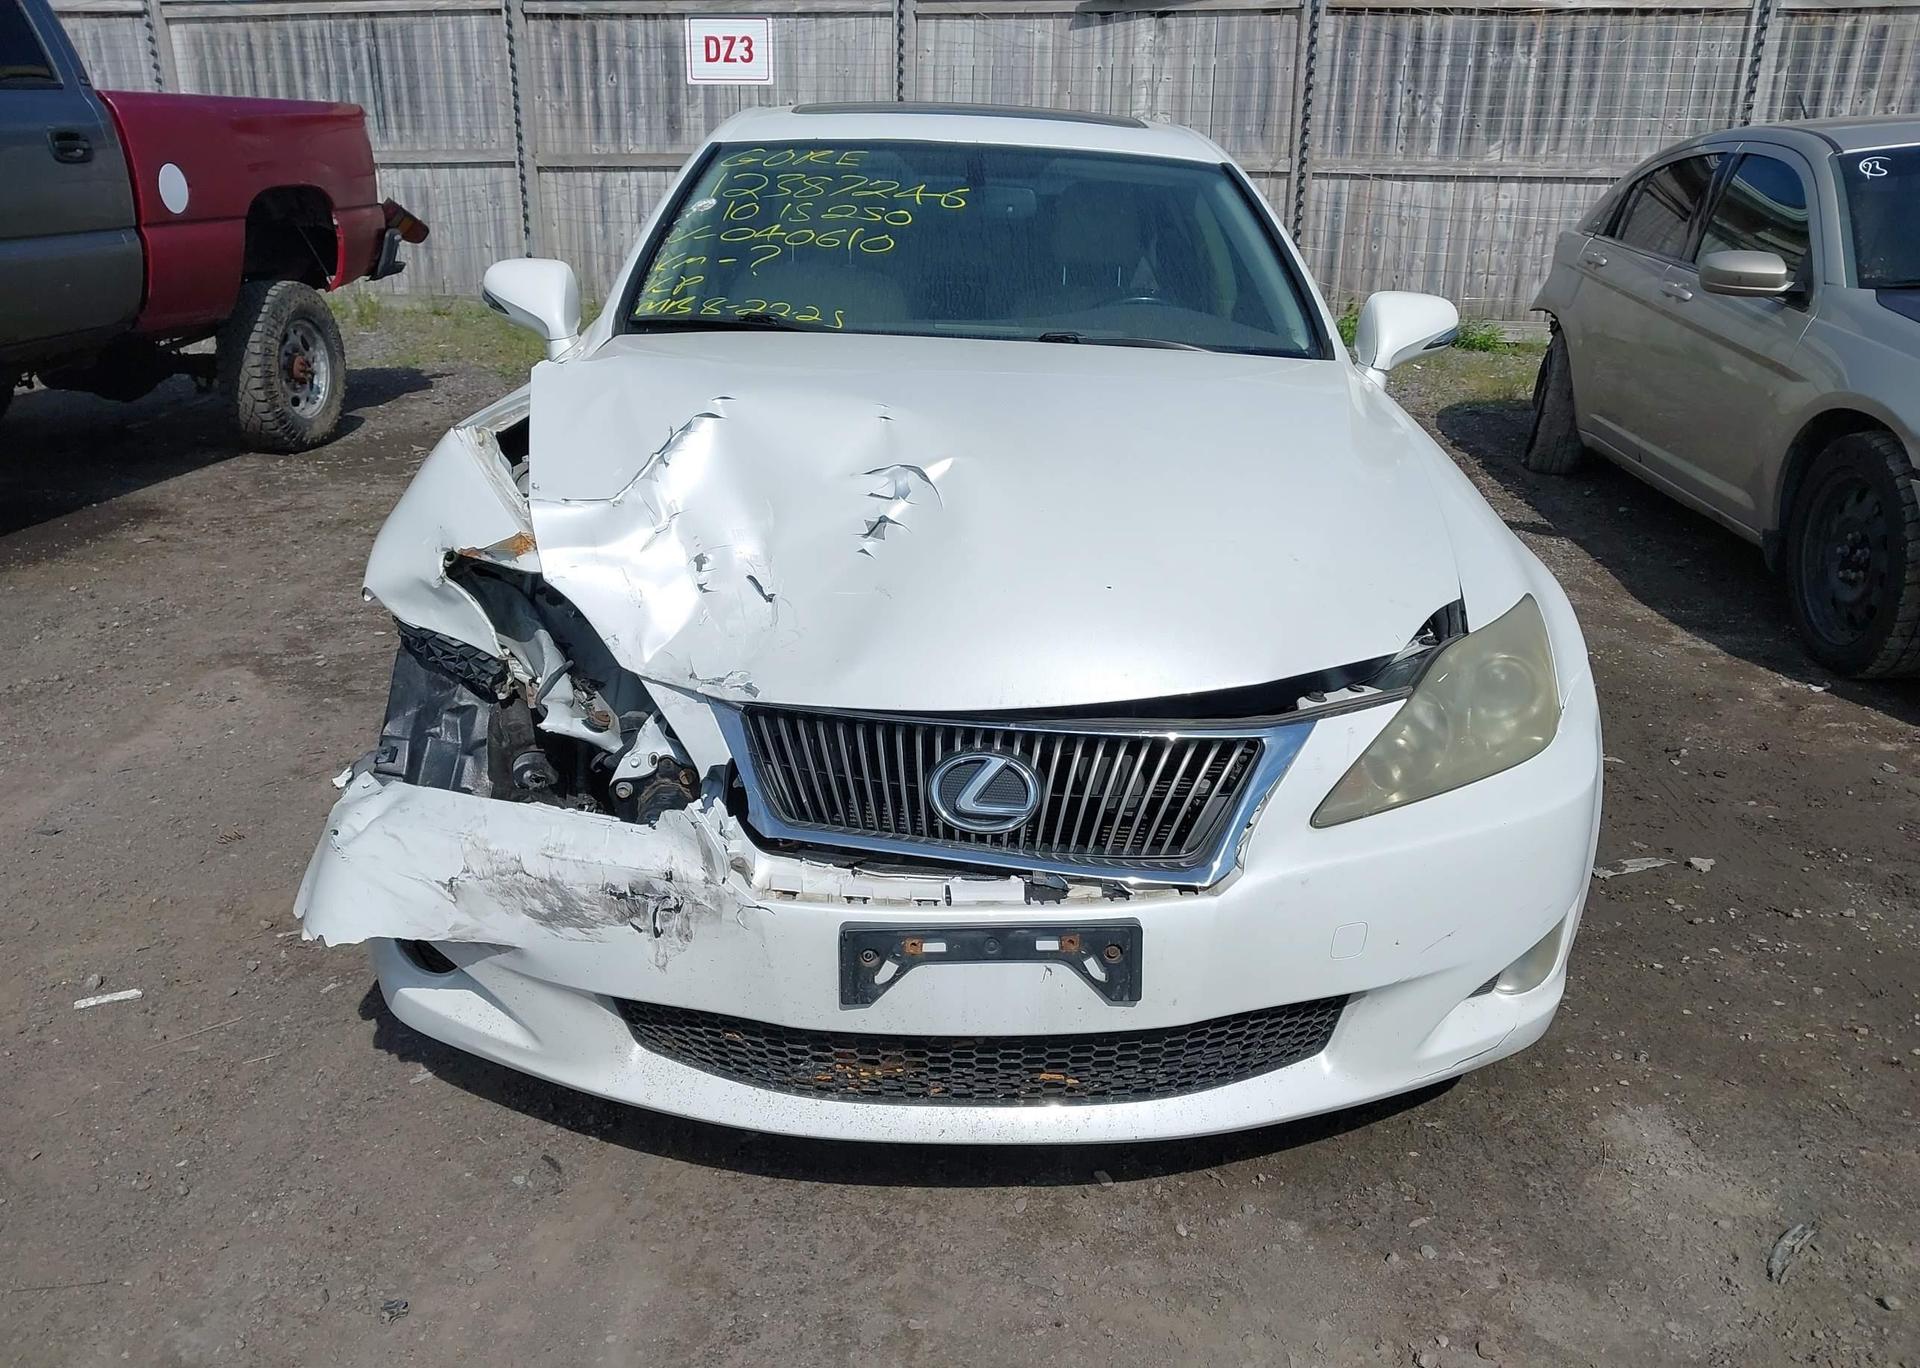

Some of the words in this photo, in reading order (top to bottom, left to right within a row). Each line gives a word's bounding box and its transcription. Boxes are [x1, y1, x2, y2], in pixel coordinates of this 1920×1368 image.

[704, 35, 754, 63] DZ3
[720, 148, 869, 167] GORE
[722, 200, 760, 222] 10
[820, 204, 913, 226] 250
[750, 244, 782, 277] ?
